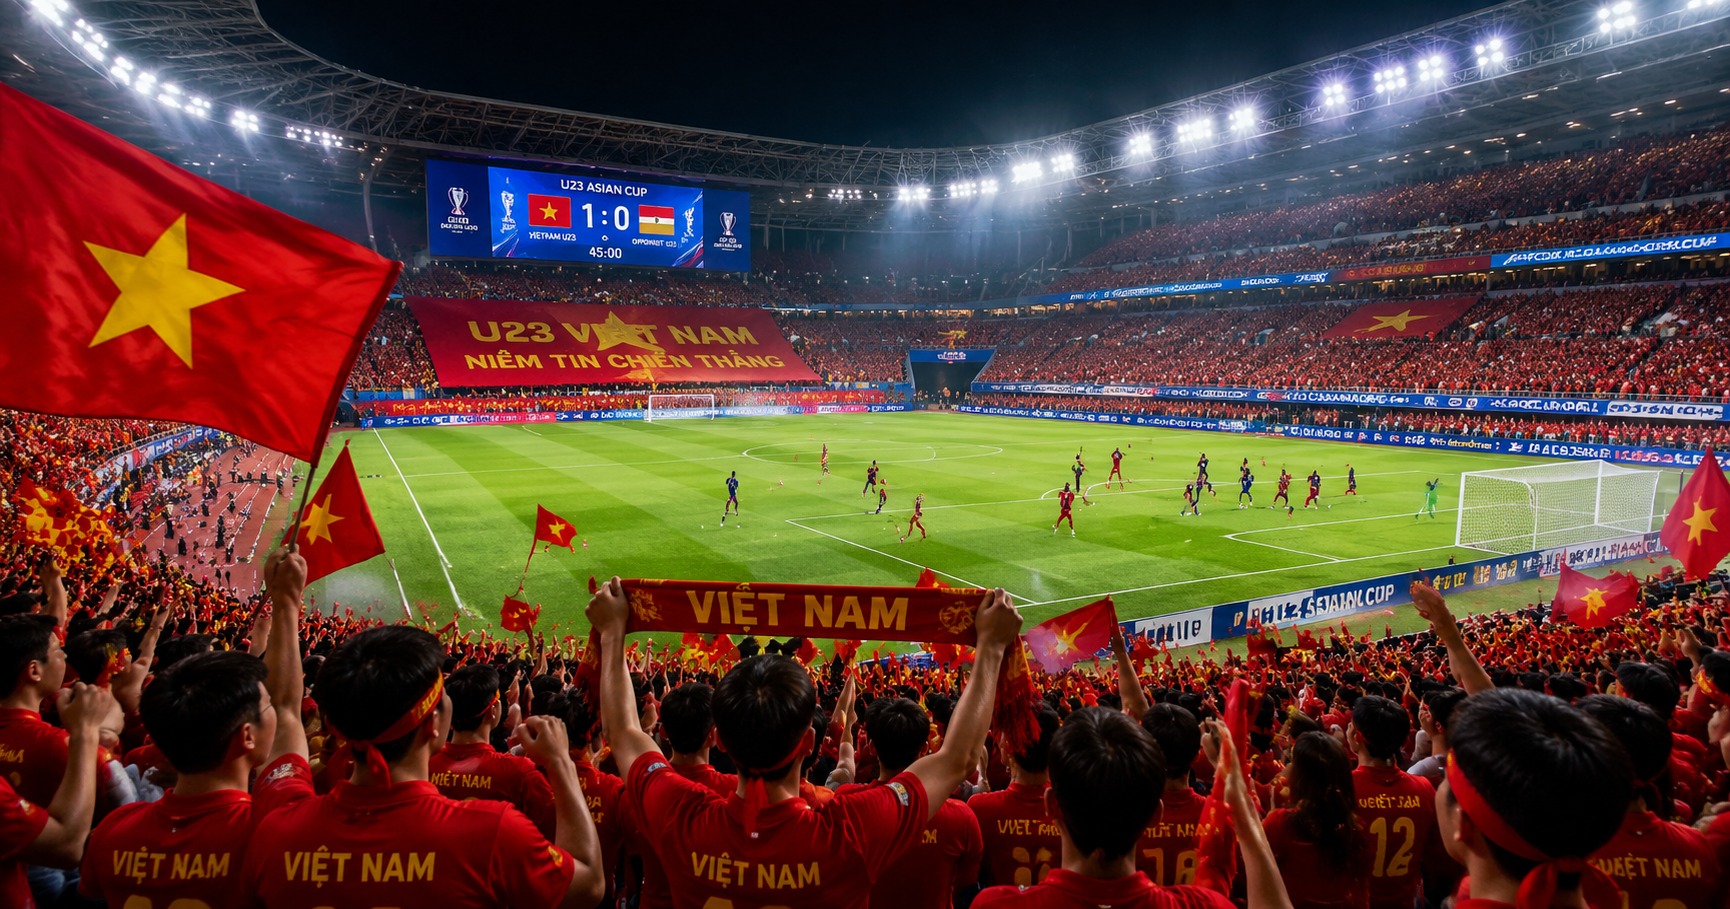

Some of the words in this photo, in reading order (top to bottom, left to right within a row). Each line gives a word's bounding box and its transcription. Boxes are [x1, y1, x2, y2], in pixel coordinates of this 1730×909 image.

[560, 179, 584, 191] U23
[586, 182, 622, 195] ASIAN
[624, 186, 648, 198] CUP
[589, 247, 622, 259] 45:00
[467, 321, 555, 343] U23
[667, 325, 760, 345] NAM
[549, 354, 601, 369] TIN
[1365, 583, 1395, 606] CUP
[686, 582, 786, 633] VIỆT
[804, 594, 909, 631] NAM
[461, 774, 492, 790] NAM
[1369, 816, 1416, 878] 12
[170, 852, 231, 880] NAM
[284, 845, 352, 888] VIỆT
[361, 852, 436, 882] NAM
[691, 851, 750, 889] VIỆT
[757, 861, 821, 889] NAM
[1653, 858, 1702, 879] NAM
